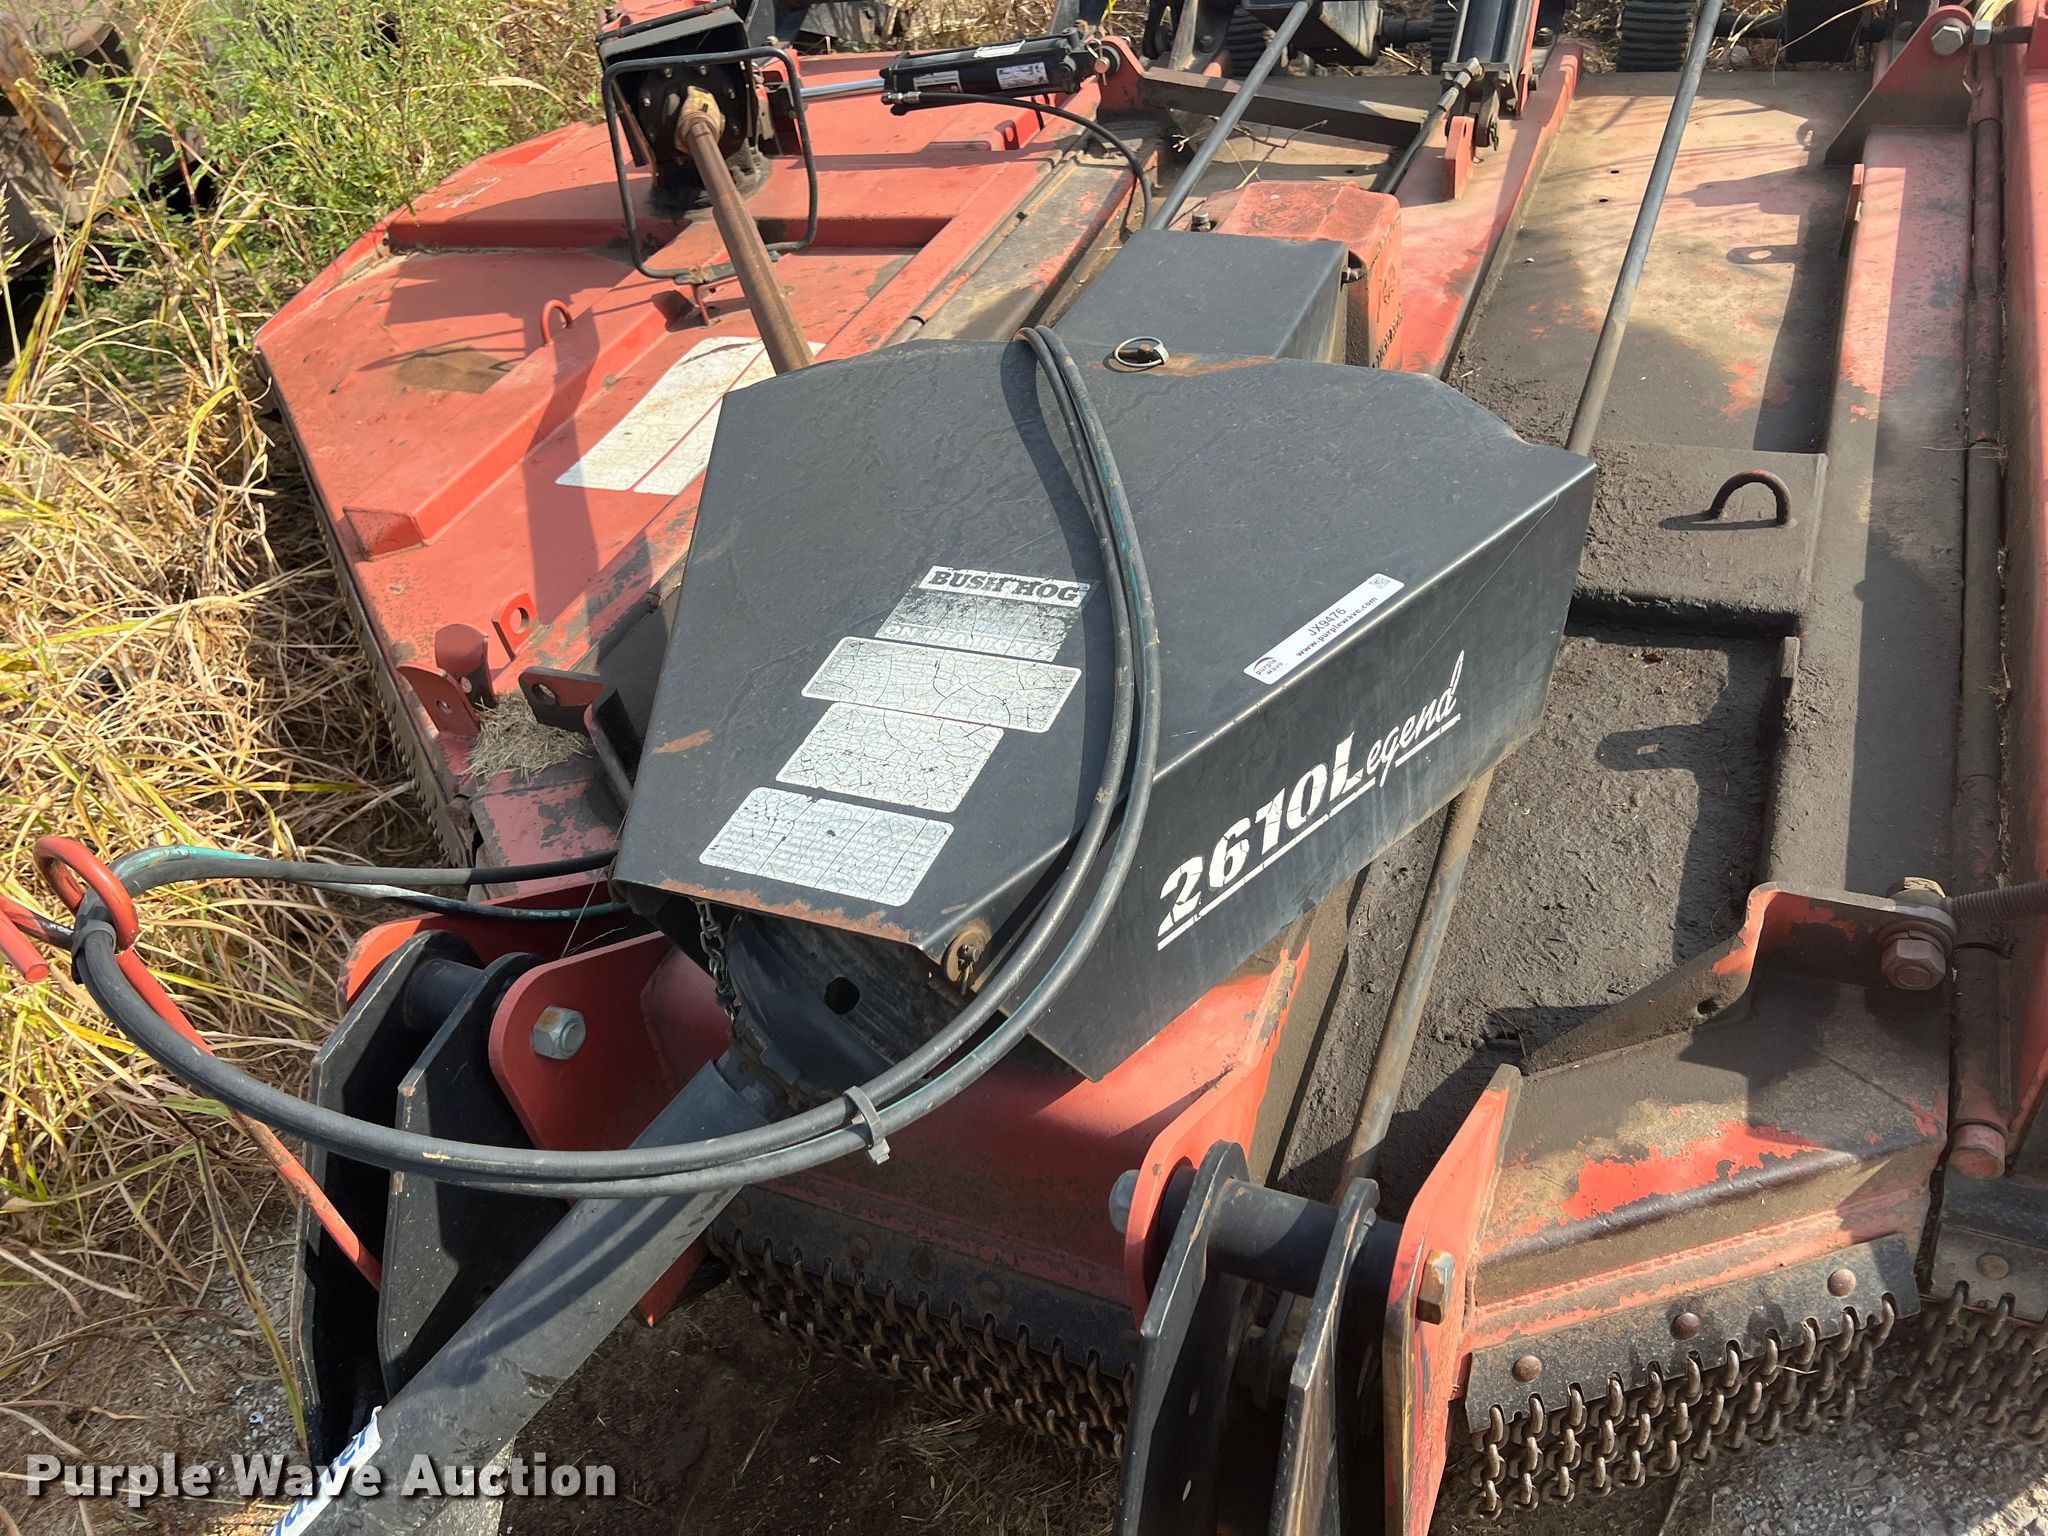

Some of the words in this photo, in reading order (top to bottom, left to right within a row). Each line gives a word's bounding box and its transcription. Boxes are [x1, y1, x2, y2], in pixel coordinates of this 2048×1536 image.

[928, 570, 1006, 593] BUSH
[1011, 579, 1080, 602] HOG
[1296, 596, 1379, 657] www.purplewave.com
[1306, 607, 1347, 637] JX9476
